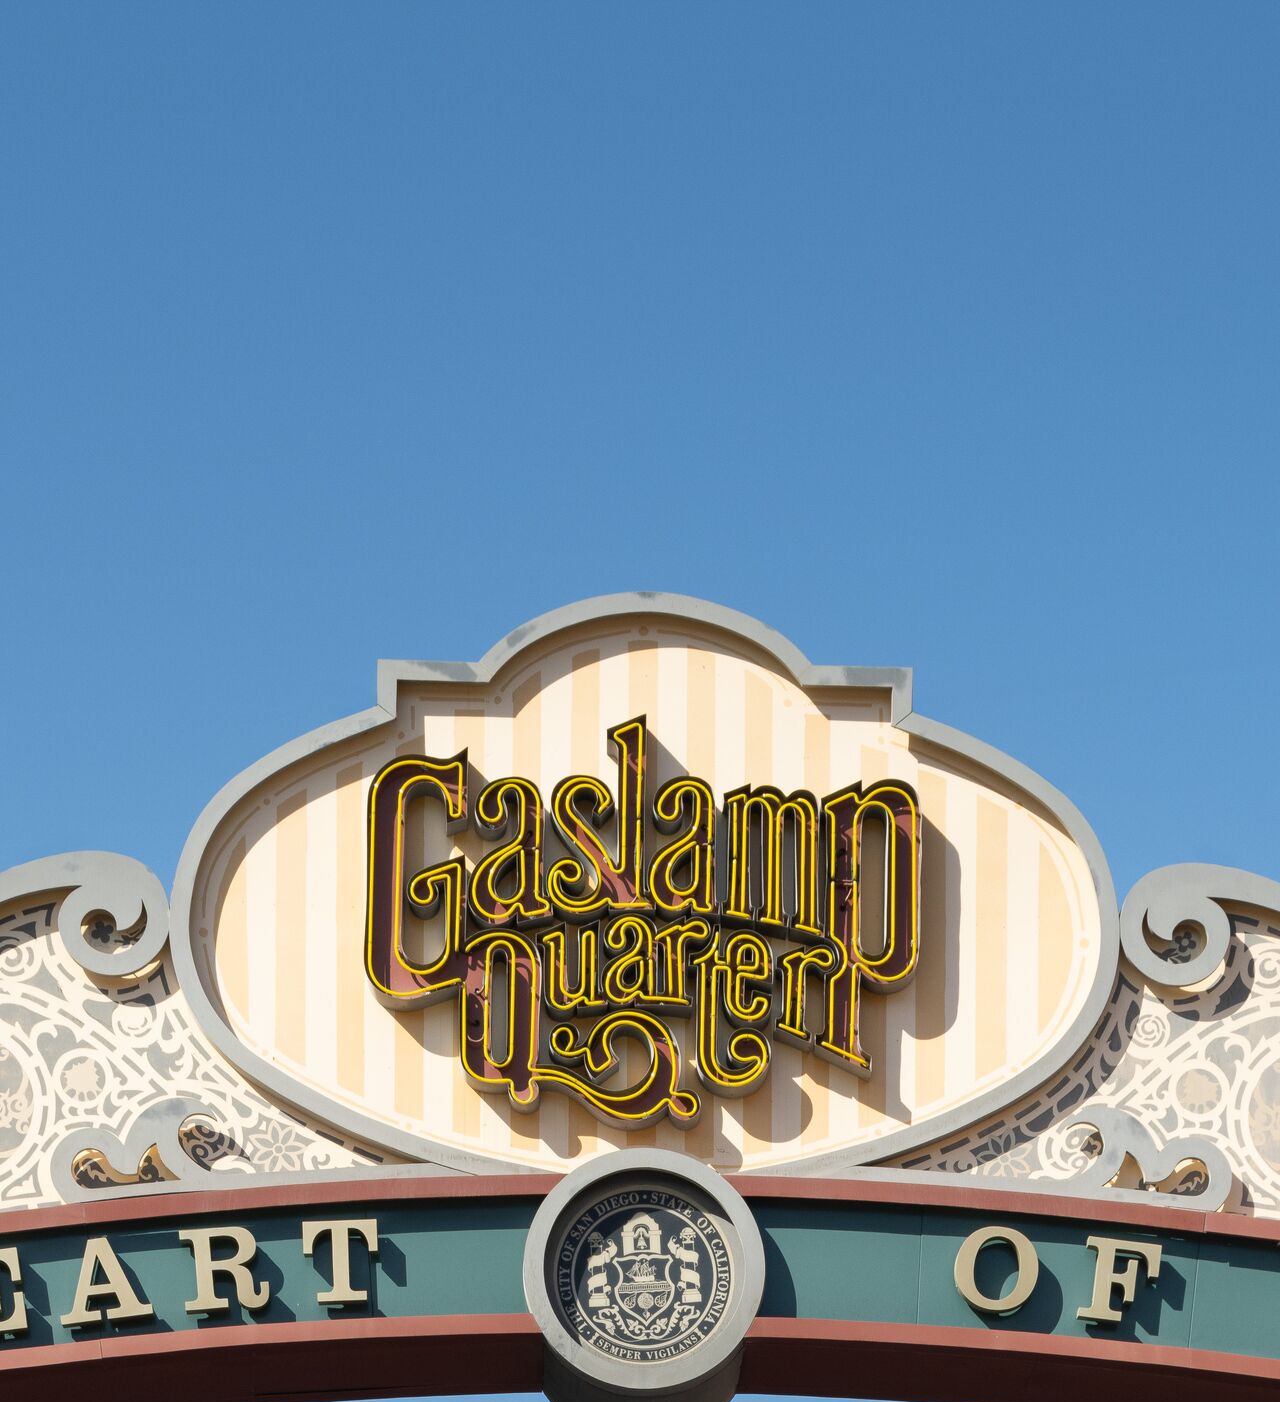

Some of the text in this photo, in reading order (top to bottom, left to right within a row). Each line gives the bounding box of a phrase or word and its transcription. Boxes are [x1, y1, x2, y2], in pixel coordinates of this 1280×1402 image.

[364, 713, 924, 1080] Gaslamp
[459, 914, 848, 1132] Quarter
[557, 1191, 641, 1335] THE CITY OF SAN DIEGO
[649, 1191, 730, 1325] STATE OF CALIFORNIA
[953, 1225, 1163, 1325] OF
[596, 1335, 699, 1361] SEMPER VIGILANS
